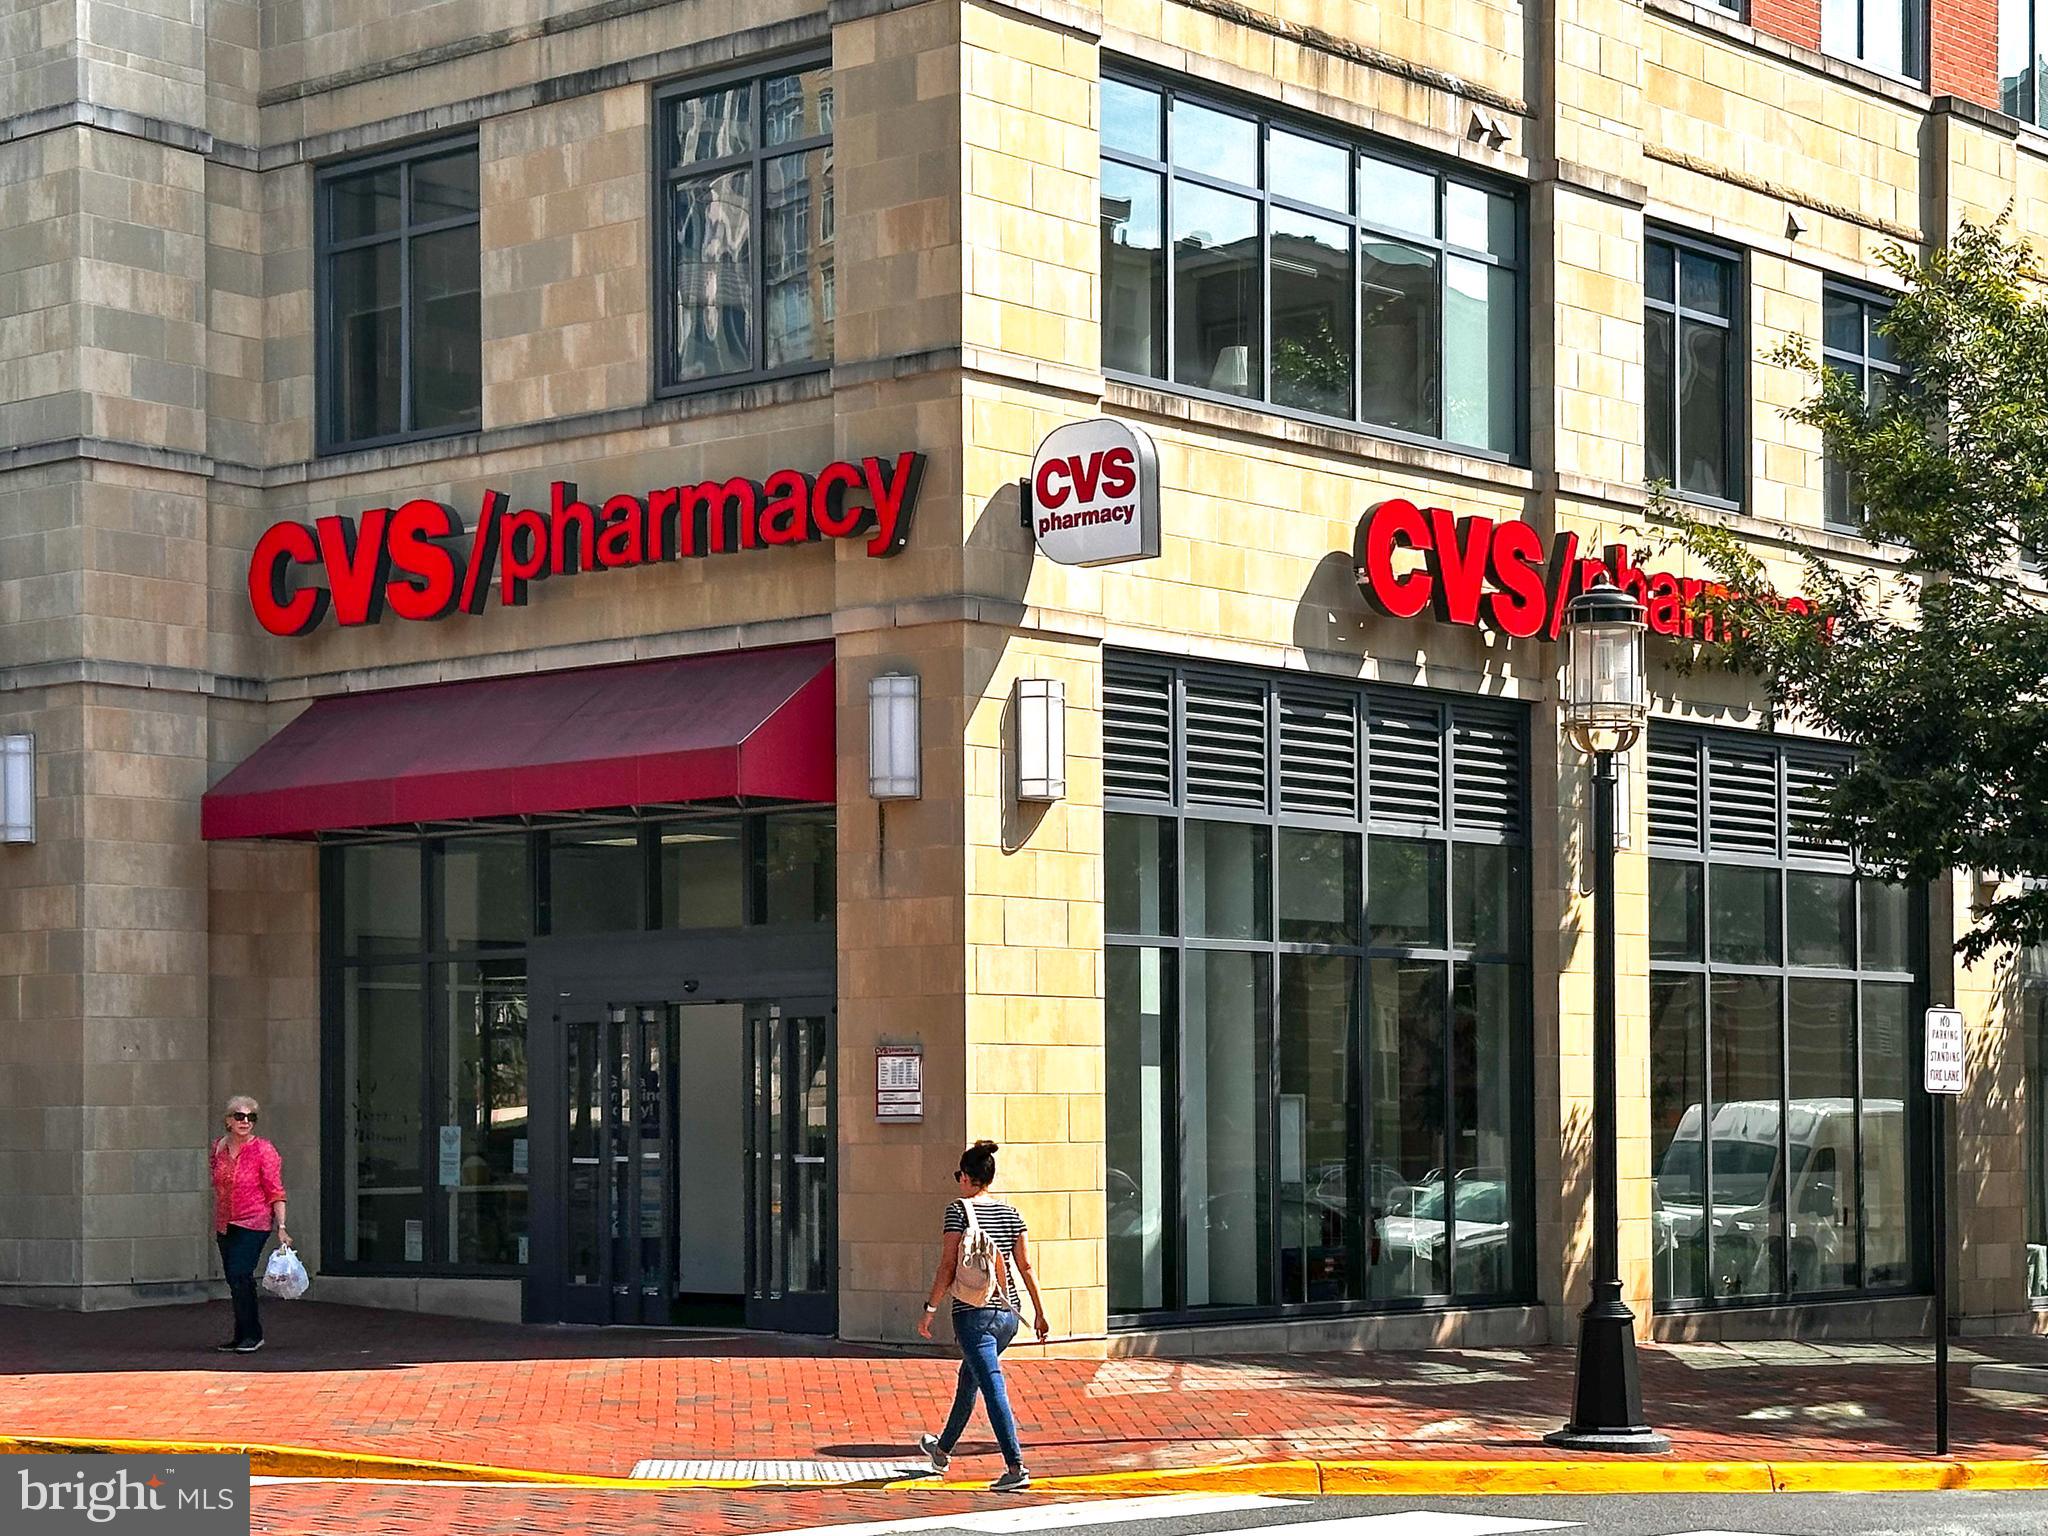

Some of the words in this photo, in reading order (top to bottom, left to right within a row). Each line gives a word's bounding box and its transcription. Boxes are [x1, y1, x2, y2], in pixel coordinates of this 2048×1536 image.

[1036, 447, 1136, 510] CVS
[1038, 504, 1135, 538] pharmacy
[1940, 1015, 1950, 1027] NO
[1932, 1029, 1958, 1040] PARKING
[1930, 1051, 1960, 1062] STANDING
[1930, 1069, 1943, 1081] FIRE
[1944, 1070, 1959, 1081] LANE
